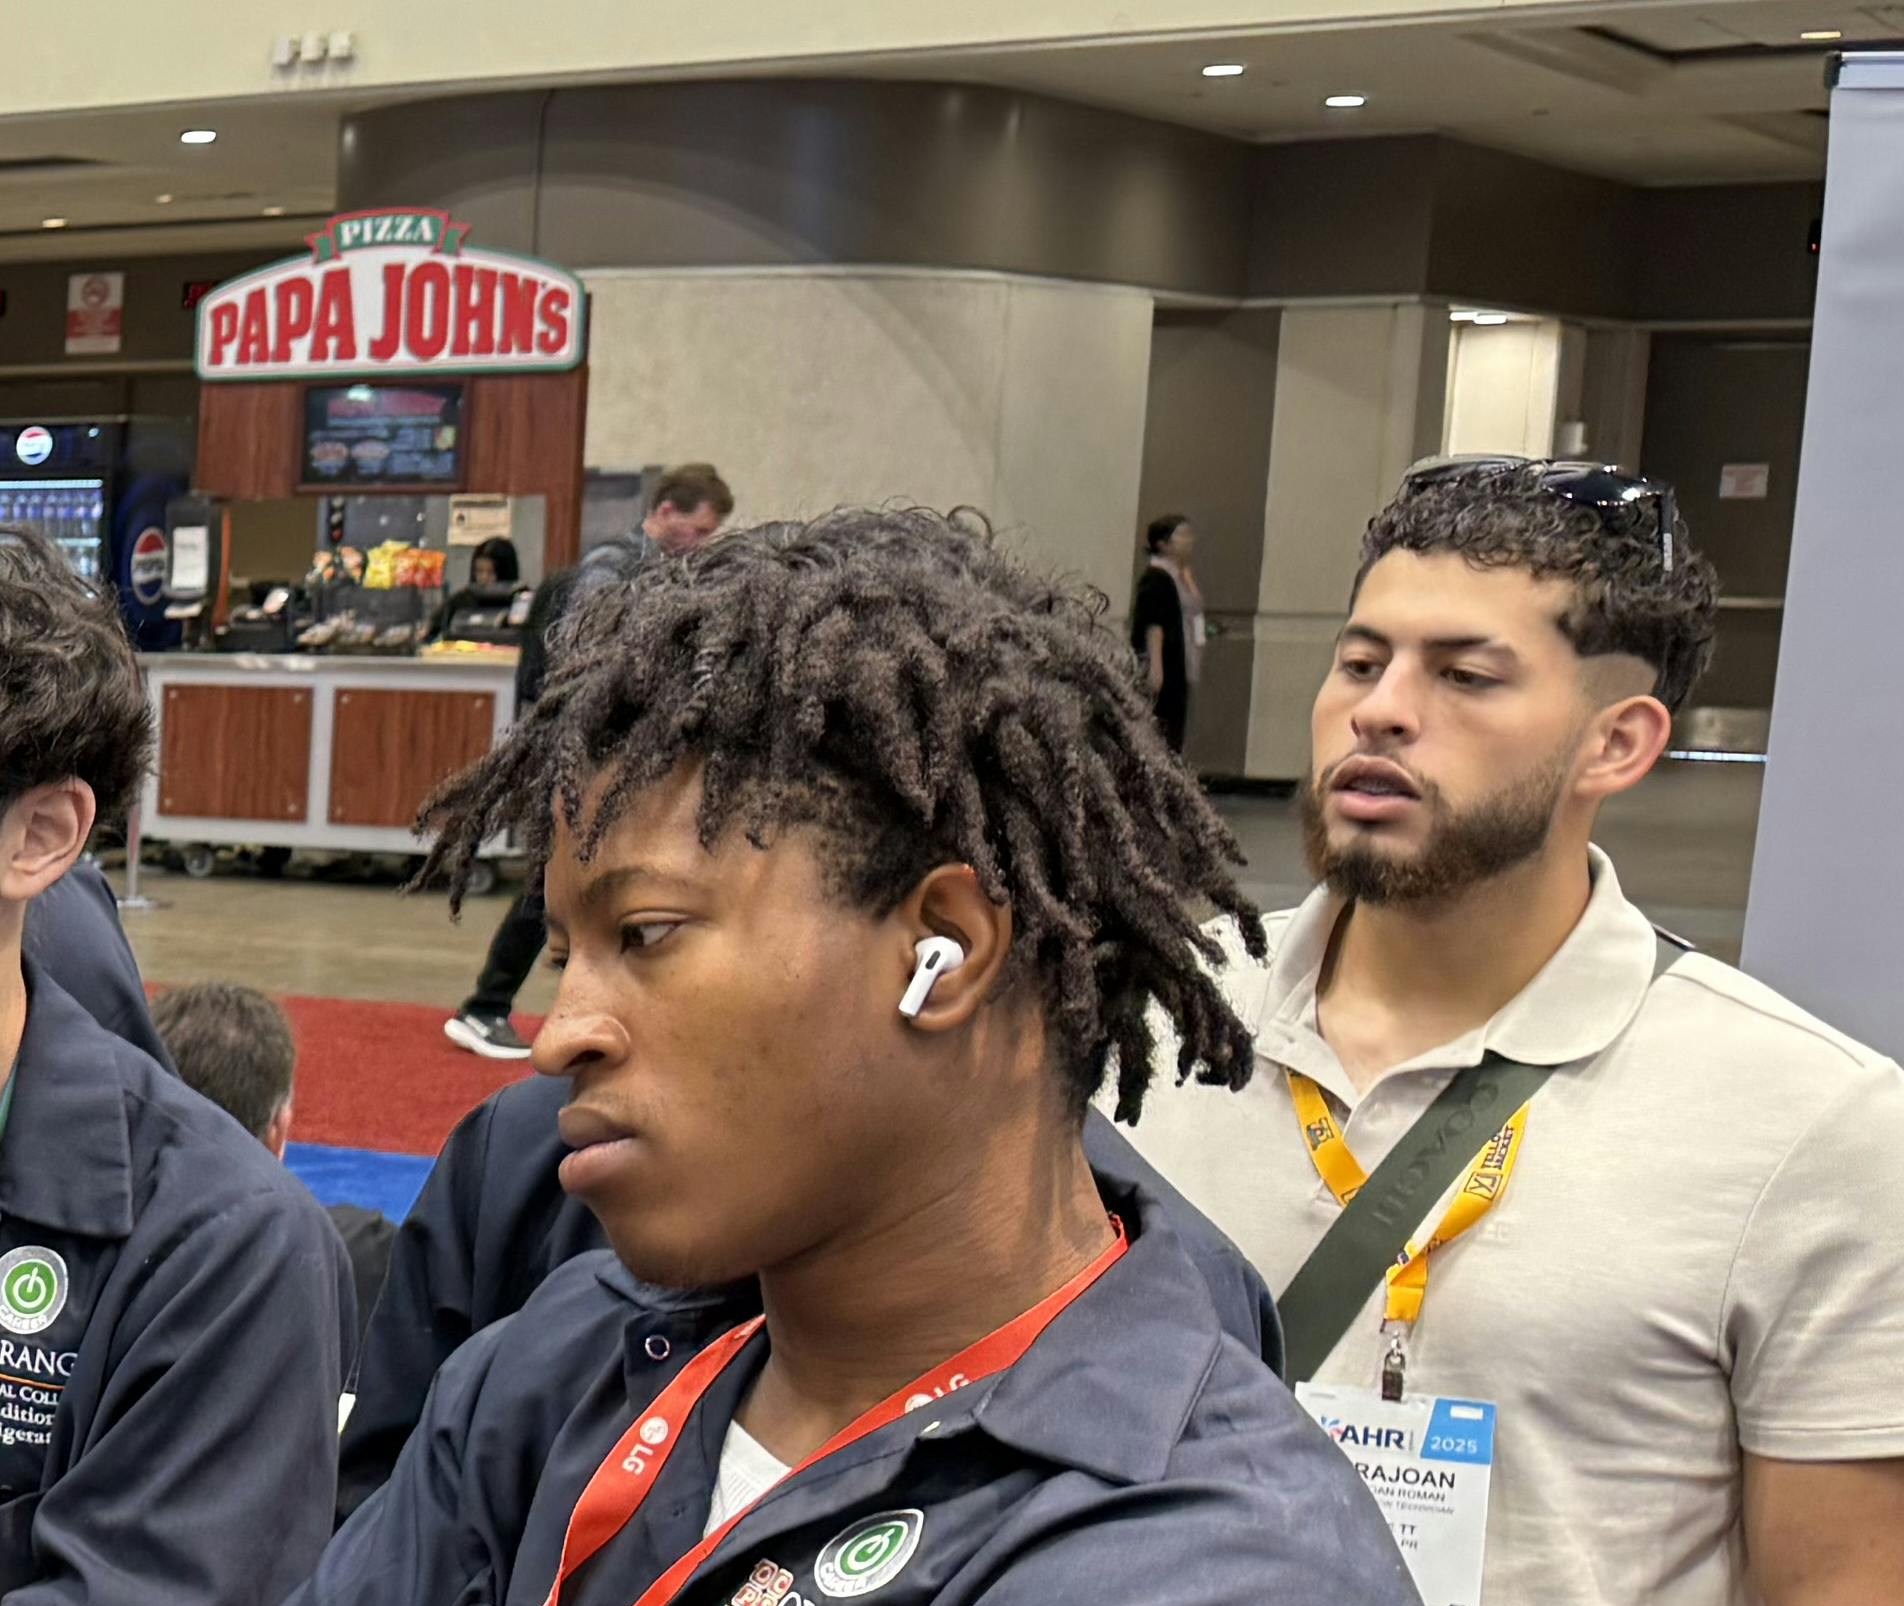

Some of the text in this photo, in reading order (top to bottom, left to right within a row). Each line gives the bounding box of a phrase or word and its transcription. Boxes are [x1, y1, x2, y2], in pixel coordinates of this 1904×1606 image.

[340, 216, 435, 246] PIZZA
[208, 260, 570, 366] PAPA JOHN'S
[1339, 1425, 1478, 1454] AHR 2025
[622, 1445, 655, 1476] LG
